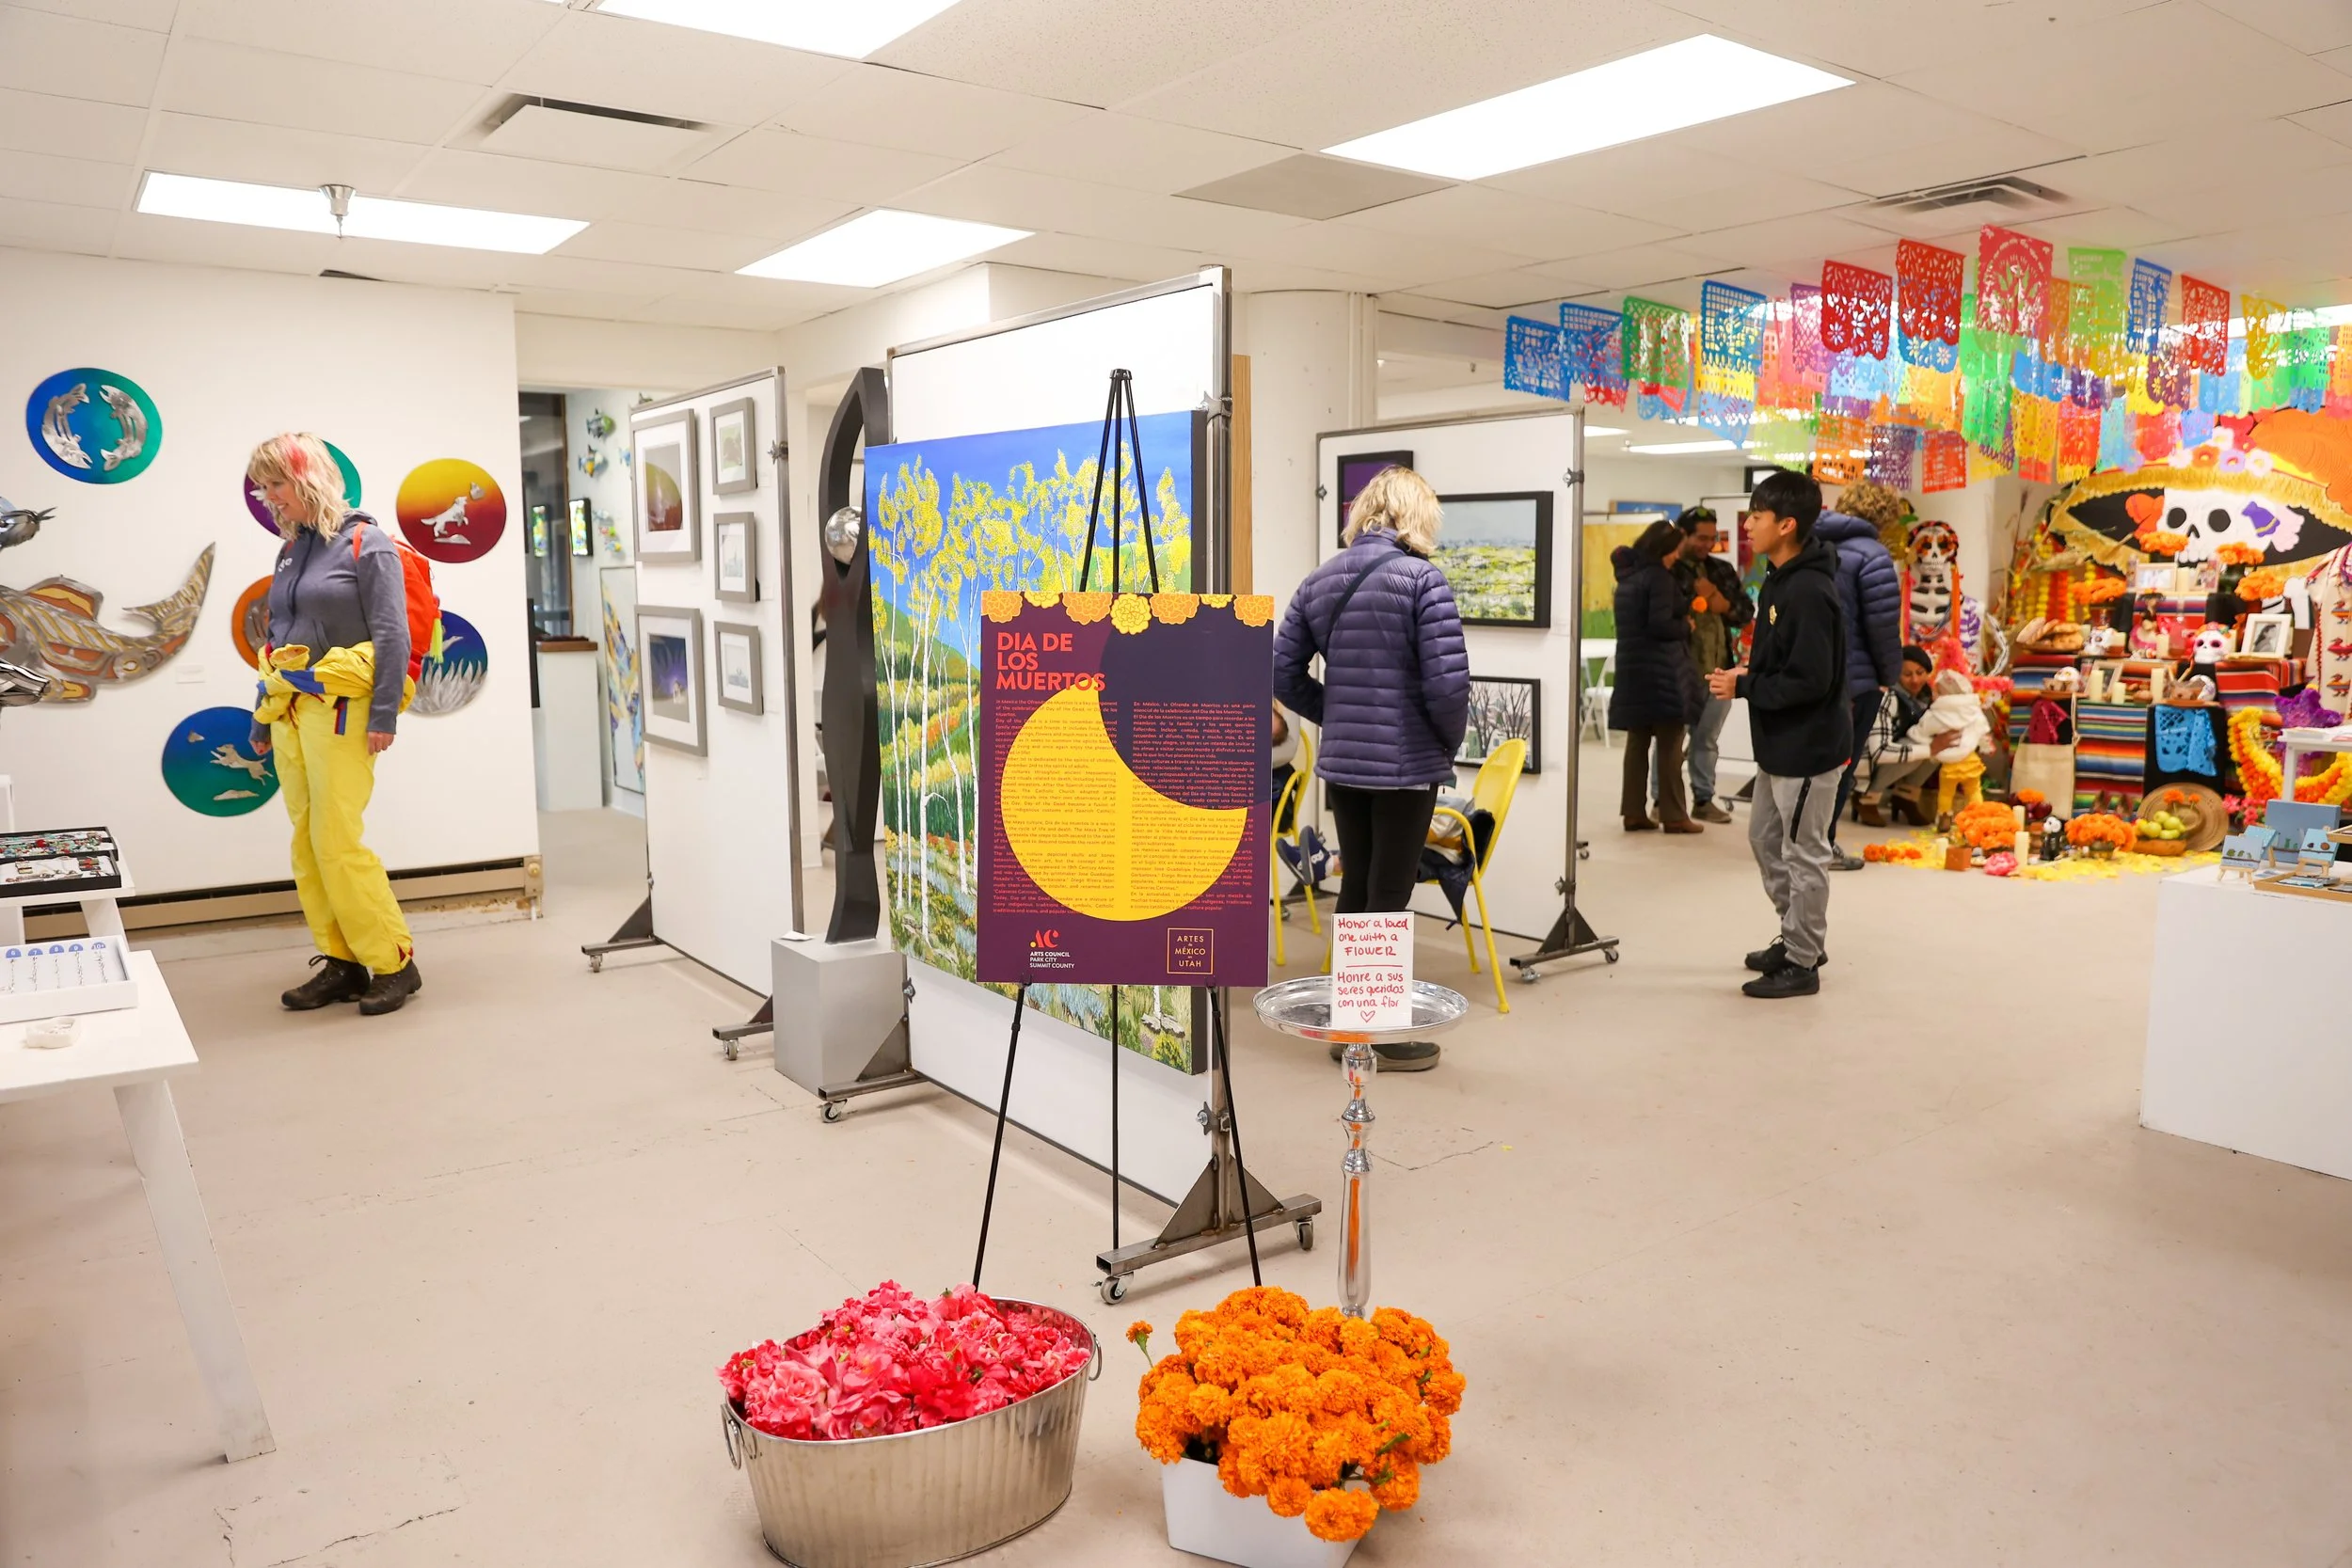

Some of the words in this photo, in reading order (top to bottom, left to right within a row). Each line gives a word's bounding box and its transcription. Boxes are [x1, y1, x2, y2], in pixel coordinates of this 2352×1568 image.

[997, 632, 1037, 650] DIA
[1043, 633, 1073, 651] DE
[997, 652, 1038, 671] LOS
[996, 672, 1105, 691] MUERTOS
[1338, 918, 1371, 929] Honor
[1374, 919, 1382, 928] a
[1338, 933, 1357, 942] one
[1360, 933, 1386, 941] with
[1175, 946, 1206, 955] MÉXICO
[1338, 972, 1371, 983] Honre
[1375, 973, 1383, 981] a
[1388, 973, 1403, 982] sus
[1338, 986, 1364, 995] seres
[1367, 985, 1404, 996] queridos
[1338, 999, 1354, 1008] con
[1357, 999, 1377, 1007] una
[1381, 996, 1399, 1008] flor
